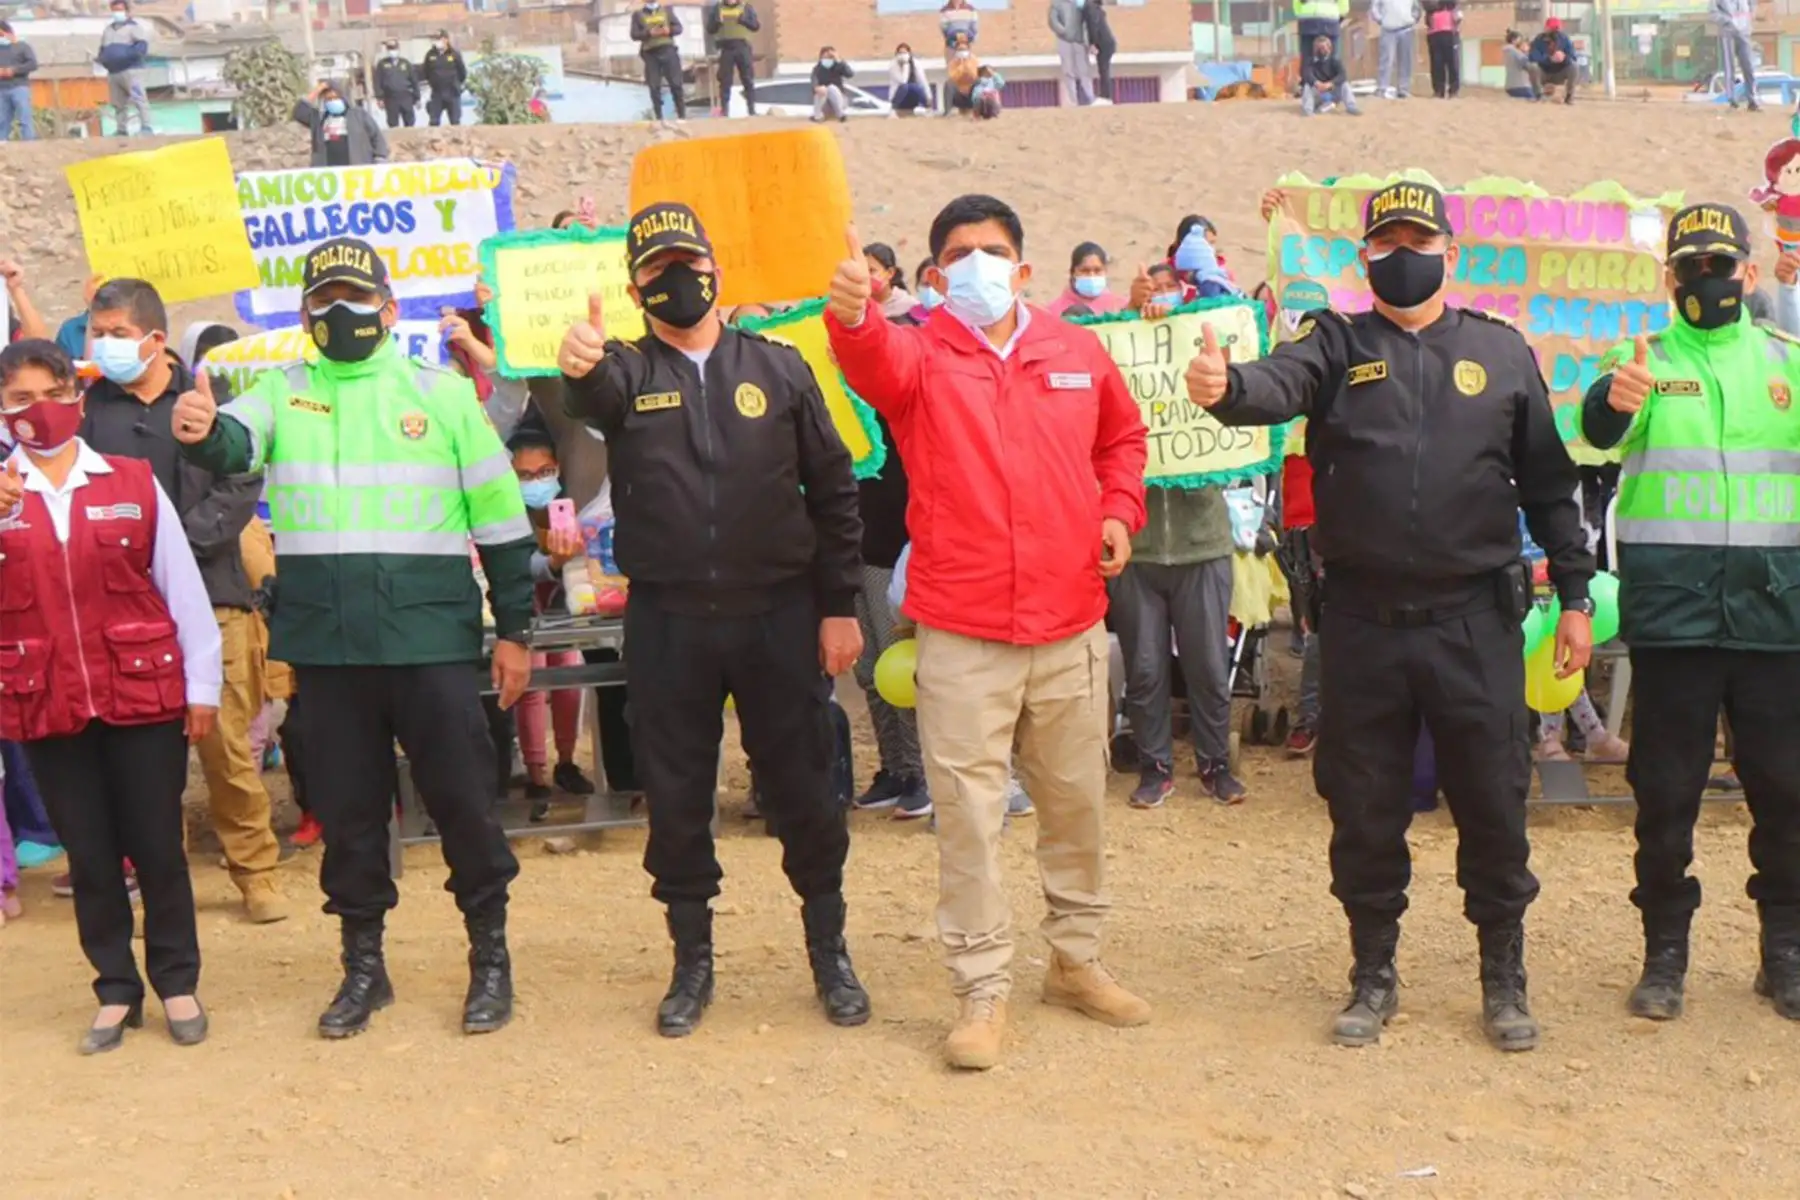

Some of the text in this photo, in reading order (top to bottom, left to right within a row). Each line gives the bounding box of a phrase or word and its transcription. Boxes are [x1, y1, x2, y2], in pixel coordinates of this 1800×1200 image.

[1306, 190, 1359, 231] LA
[1471, 195, 1627, 242] COMUN
[1372, 186, 1434, 221] POLICIA
[243, 198, 457, 249] GALLEGOS Y
[633, 211, 697, 246] POLICIA
[1674, 208, 1735, 240] POLICIA
[311, 244, 372, 278] POLICIA
[1539, 251, 1657, 293] PARA
[1528, 293, 1671, 338] SIENTE
[1147, 426, 1254, 465] TODOS
[276, 490, 445, 525] POLICIA
[1664, 476, 1796, 518] POLICIA
